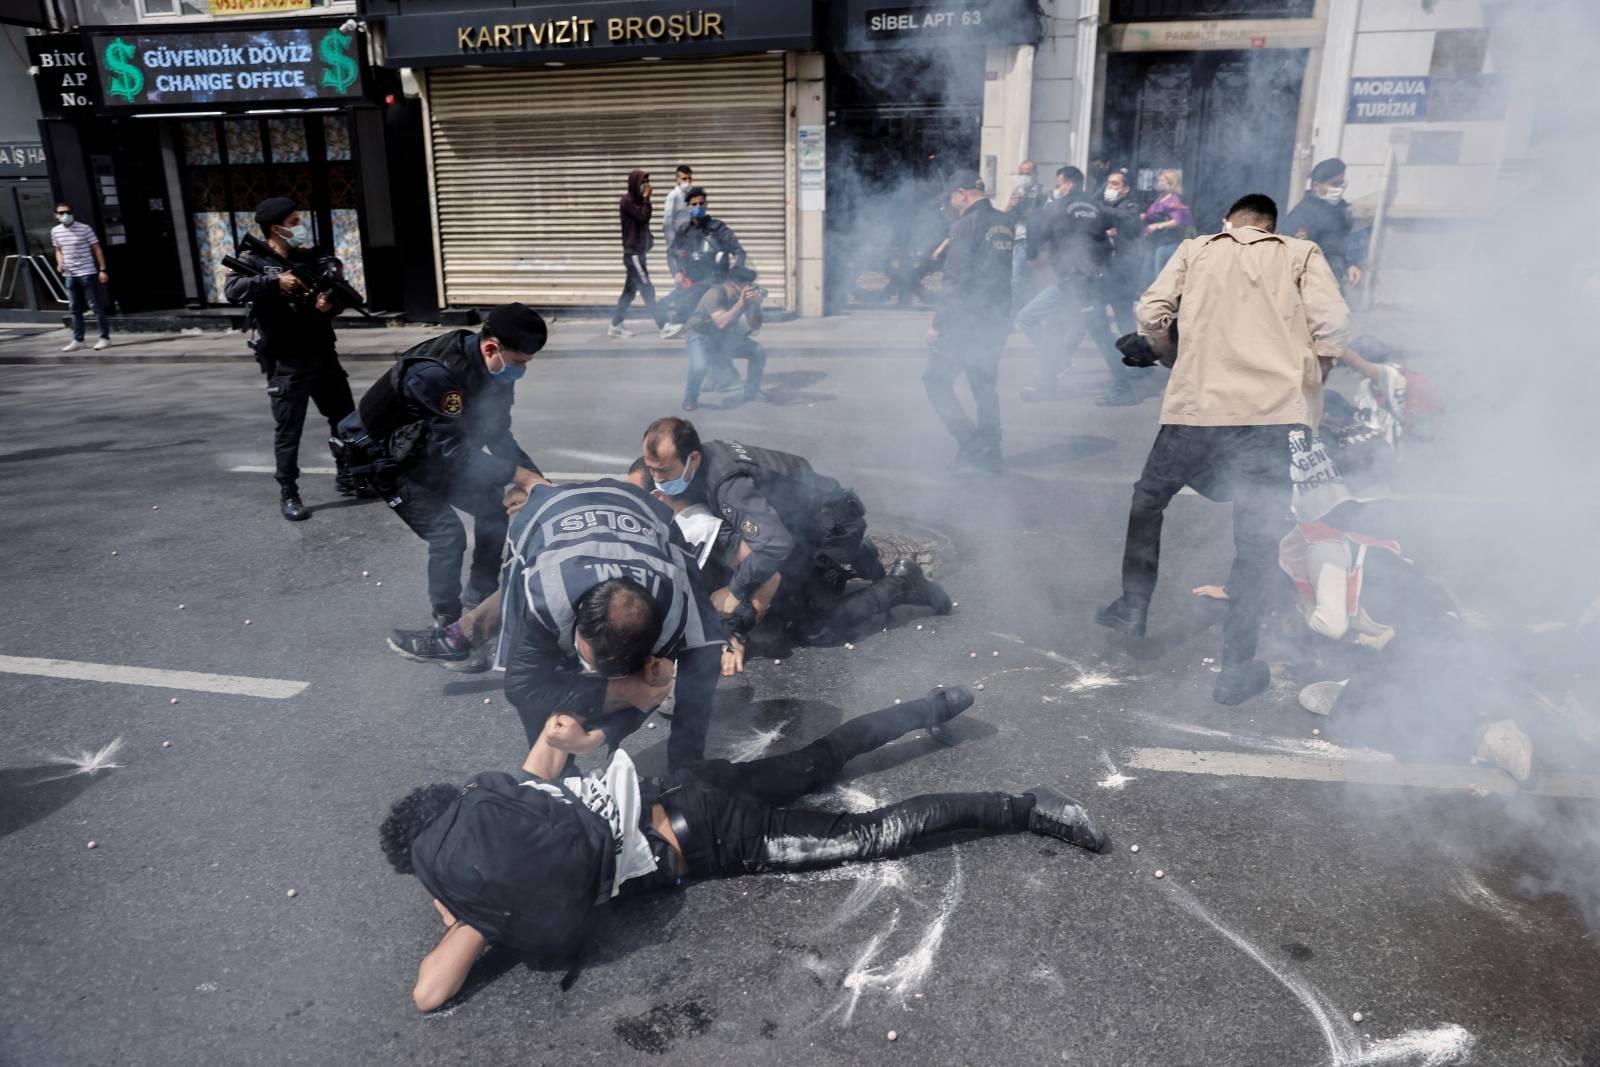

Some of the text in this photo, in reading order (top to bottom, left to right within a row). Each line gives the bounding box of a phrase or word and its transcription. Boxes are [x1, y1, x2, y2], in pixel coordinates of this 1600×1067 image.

[458, 10, 722, 49] KARTVİZİT BROŞÜR
[870, 11, 981, 31] SİBEL APT 63
[144, 44, 314, 68] GÜVENDİK DÖVİZ
[156, 70, 305, 92] CHANGE OFFICE
[1354, 80, 1426, 97] MORAVA
[61, 93, 93, 106] No.
[1356, 99, 1417, 117] TURİZM
[1299, 447, 1328, 472] GEN
